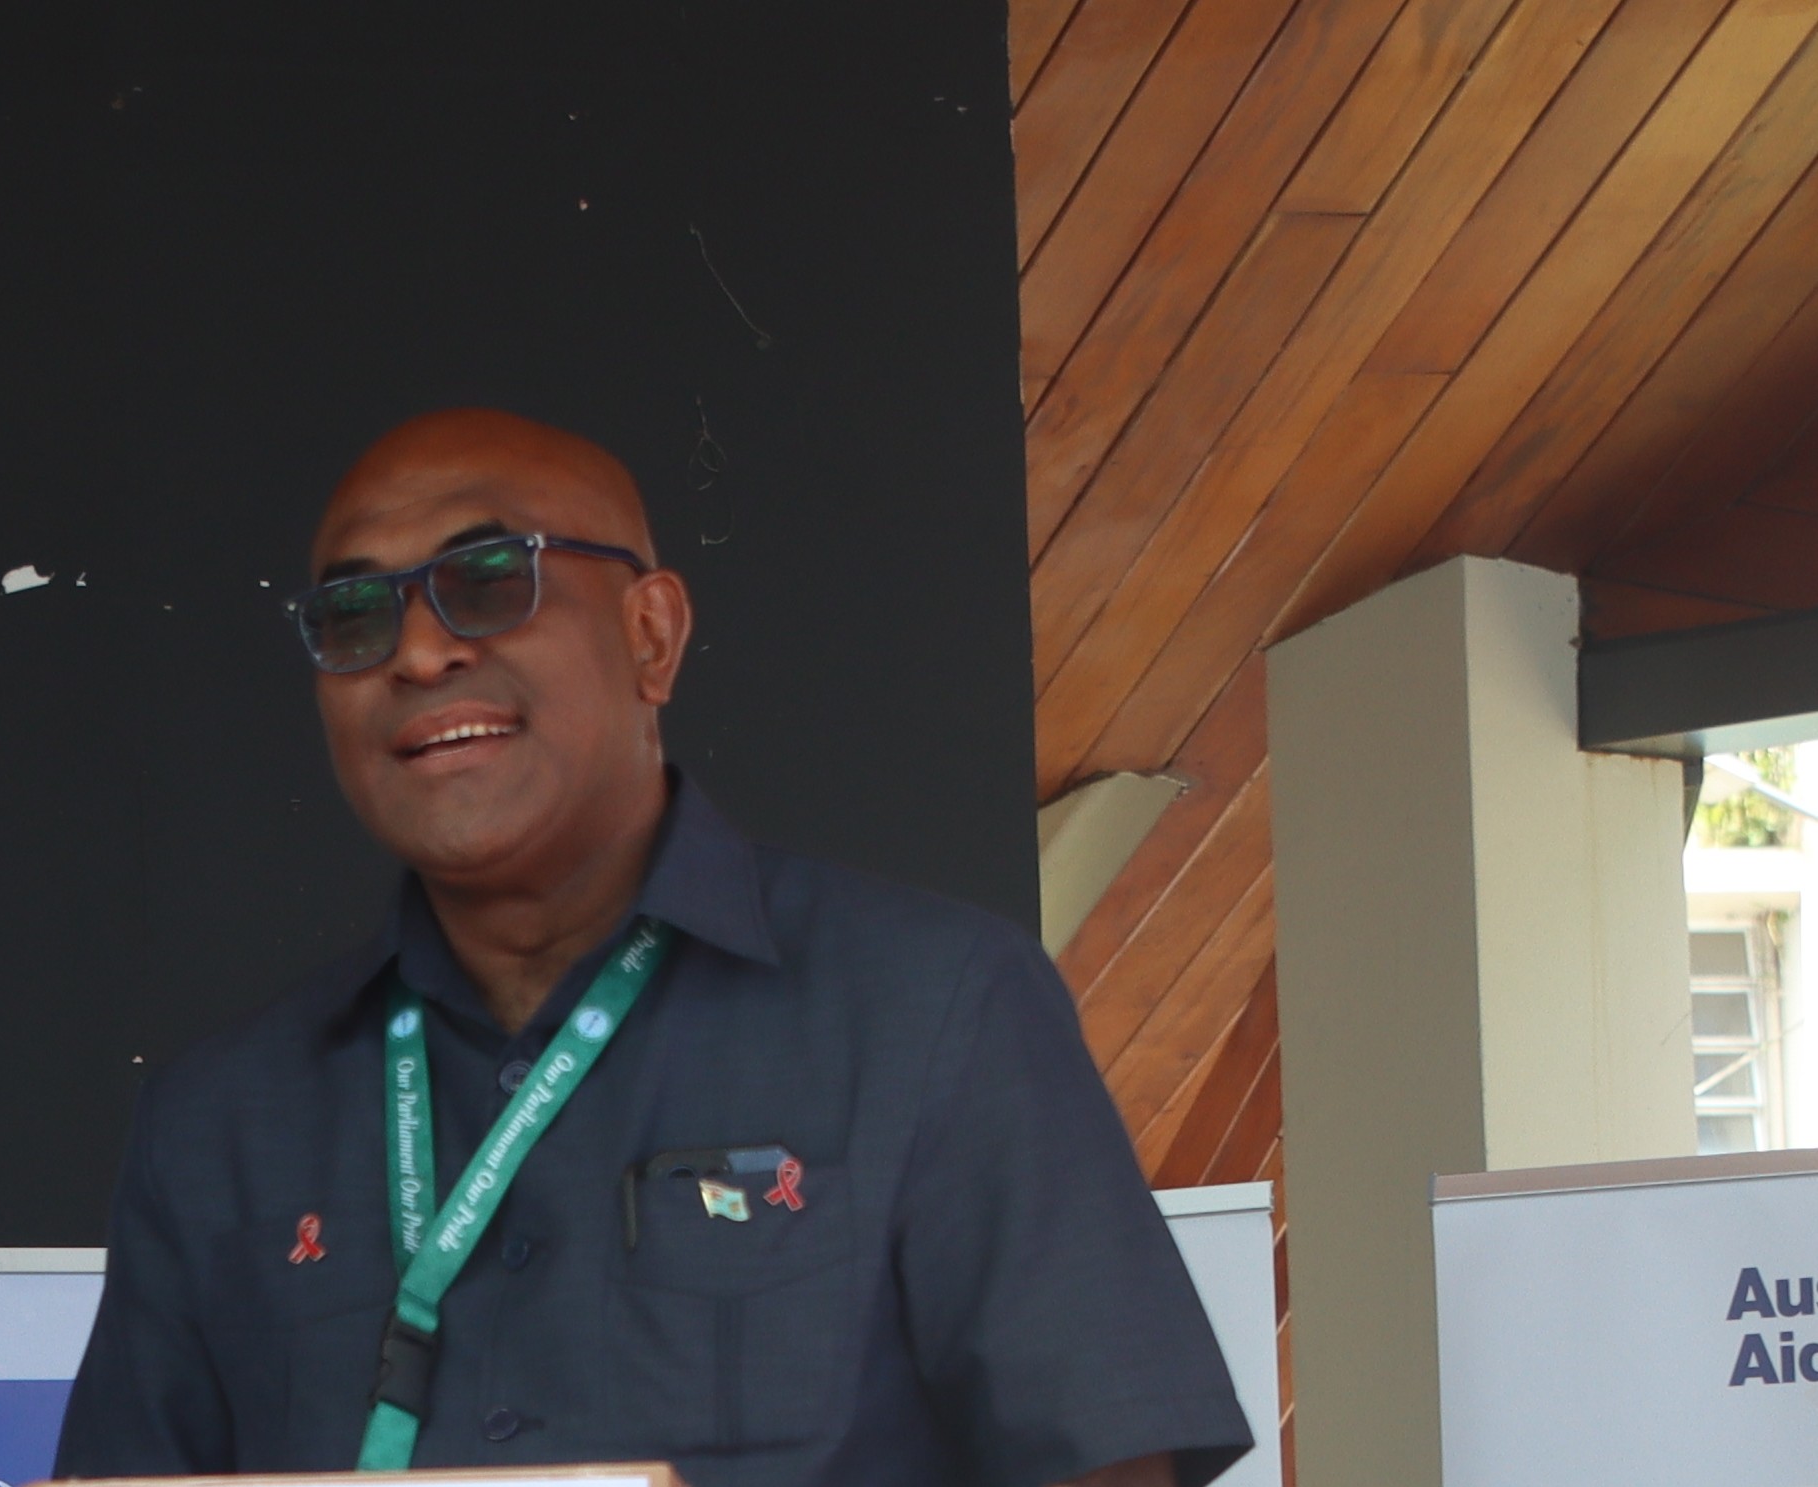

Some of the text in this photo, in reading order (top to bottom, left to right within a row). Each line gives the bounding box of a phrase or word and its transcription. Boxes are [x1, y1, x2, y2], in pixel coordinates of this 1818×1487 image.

[397, 1058, 414, 1090] Our
[398, 1092, 419, 1176] Parliament
[437, 1052, 575, 1252] Our Parliament Our Pride
[400, 1179, 420, 1211] Our
[1726, 1267, 1818, 1320] Au
